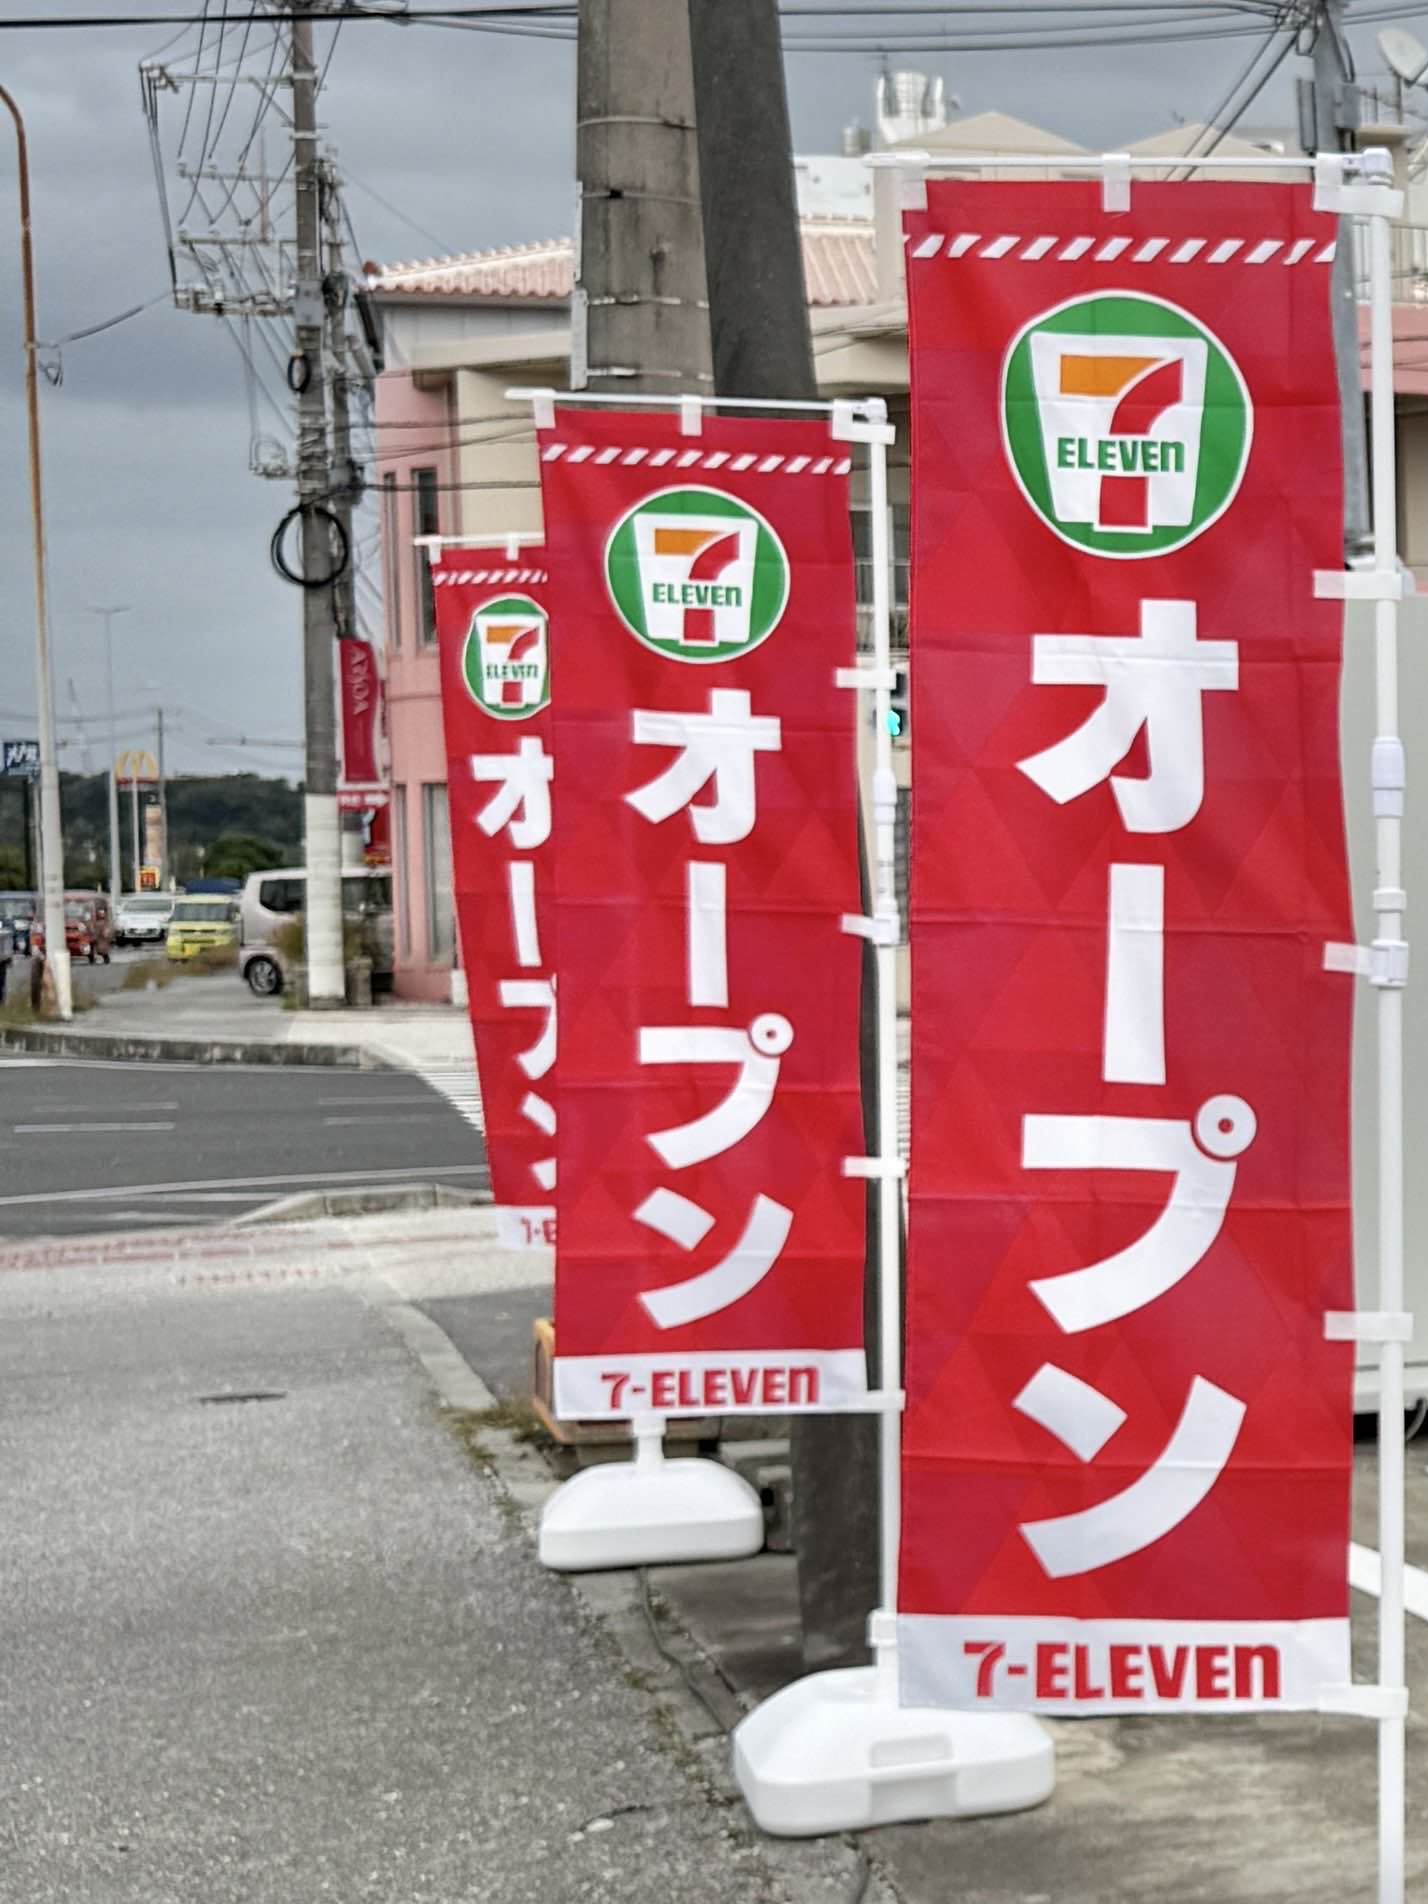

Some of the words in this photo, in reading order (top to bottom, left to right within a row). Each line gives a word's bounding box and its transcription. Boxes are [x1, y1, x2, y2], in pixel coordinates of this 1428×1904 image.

[1058, 353, 1183, 528] 7
[622, 687, 795, 1330] オープン
[1012, 597, 1258, 1579] オープン
